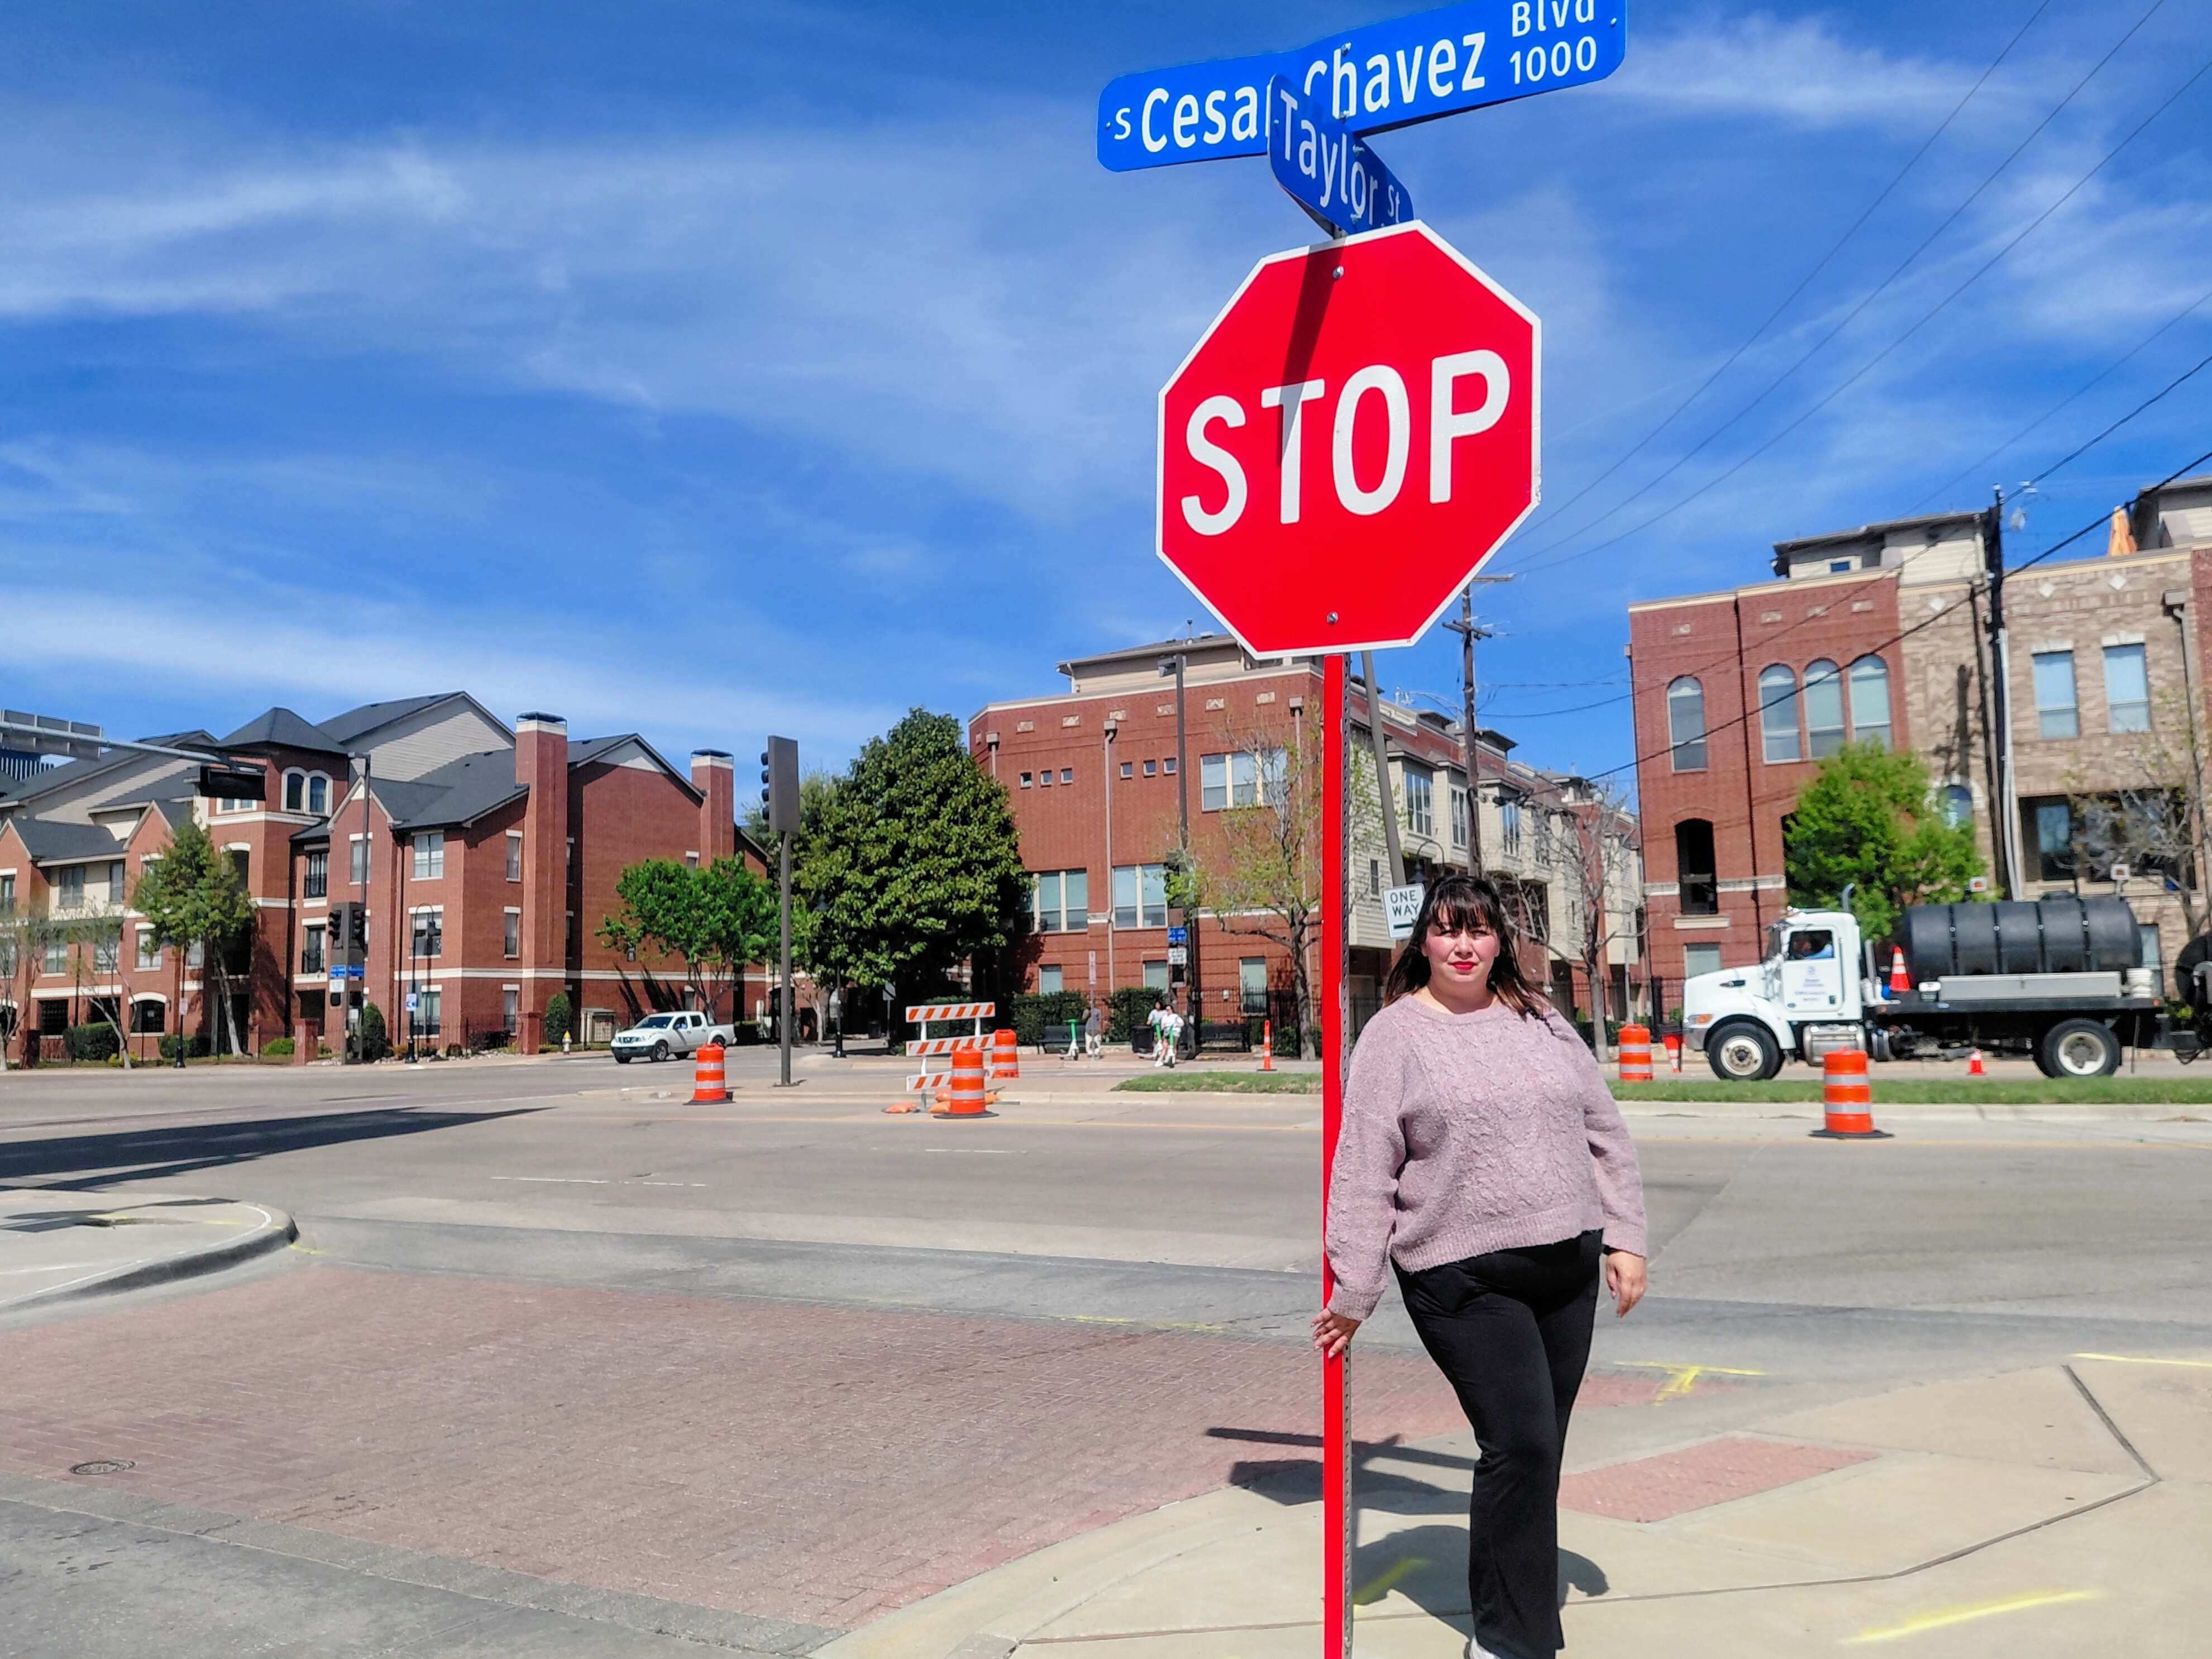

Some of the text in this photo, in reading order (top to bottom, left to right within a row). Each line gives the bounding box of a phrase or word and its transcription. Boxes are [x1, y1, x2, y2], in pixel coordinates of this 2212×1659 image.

[1512, 0, 1594, 37] Blvd
[1509, 36, 1597, 84] 1000
[1114, 107, 1131, 140] S
[1280, 89, 1401, 226] Taylor St
[1181, 349, 1511, 536] STOP
[1390, 889, 1417, 904] ONE
[1392, 902, 1420, 917] WAY
